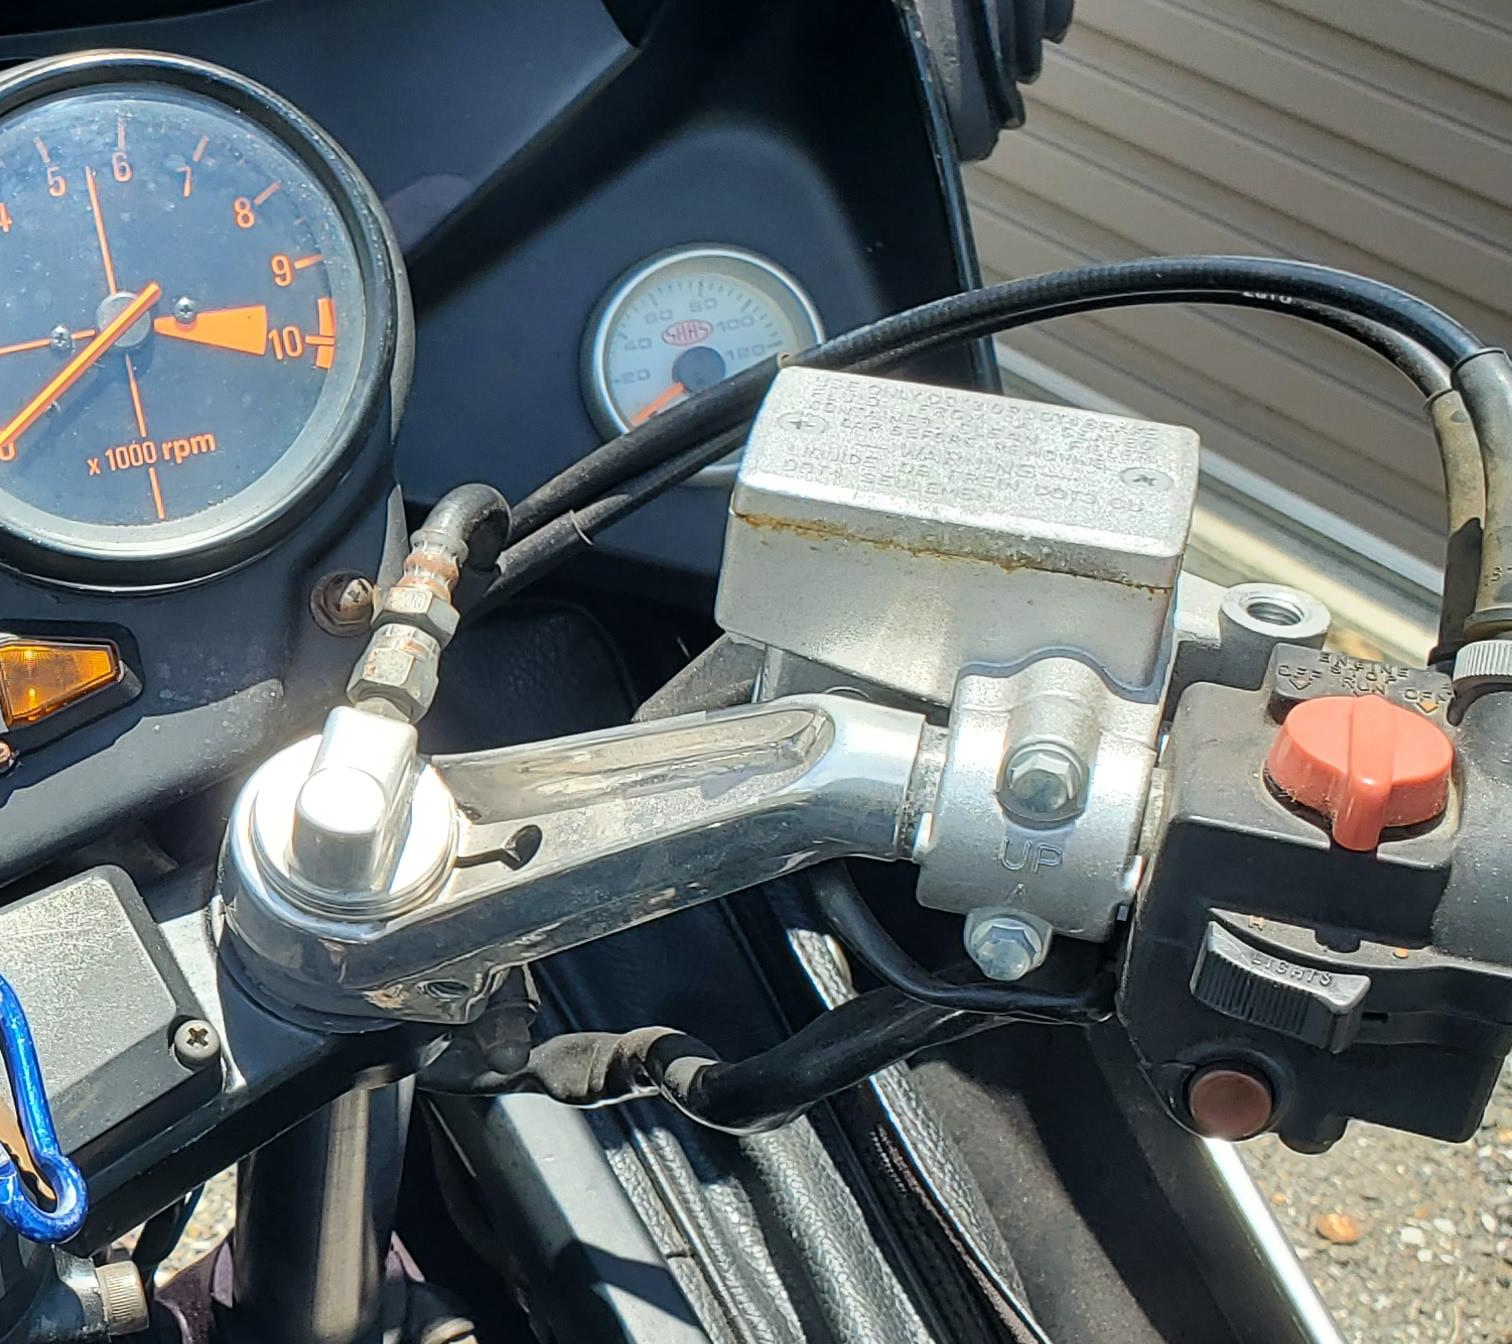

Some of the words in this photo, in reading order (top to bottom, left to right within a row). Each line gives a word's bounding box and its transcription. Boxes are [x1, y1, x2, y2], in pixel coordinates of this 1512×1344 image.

[48, 168, 67, 196] 5
[112, 153, 132, 181] 6
[177, 166, 192, 196] 7
[234, 197, 255, 228] 8
[271, 255, 294, 286] 9
[267, 326, 303, 360] 10
[106, 441, 157, 472] 1000
[162, 433, 216, 463] rpm
[1278, 665, 1322, 679] OFF
[1319, 652, 1408, 678] ENGINE
[1343, 677, 1386, 696] RUN
[999, 839, 1064, 874] UP
[1250, 953, 1334, 987] LIGHTS
